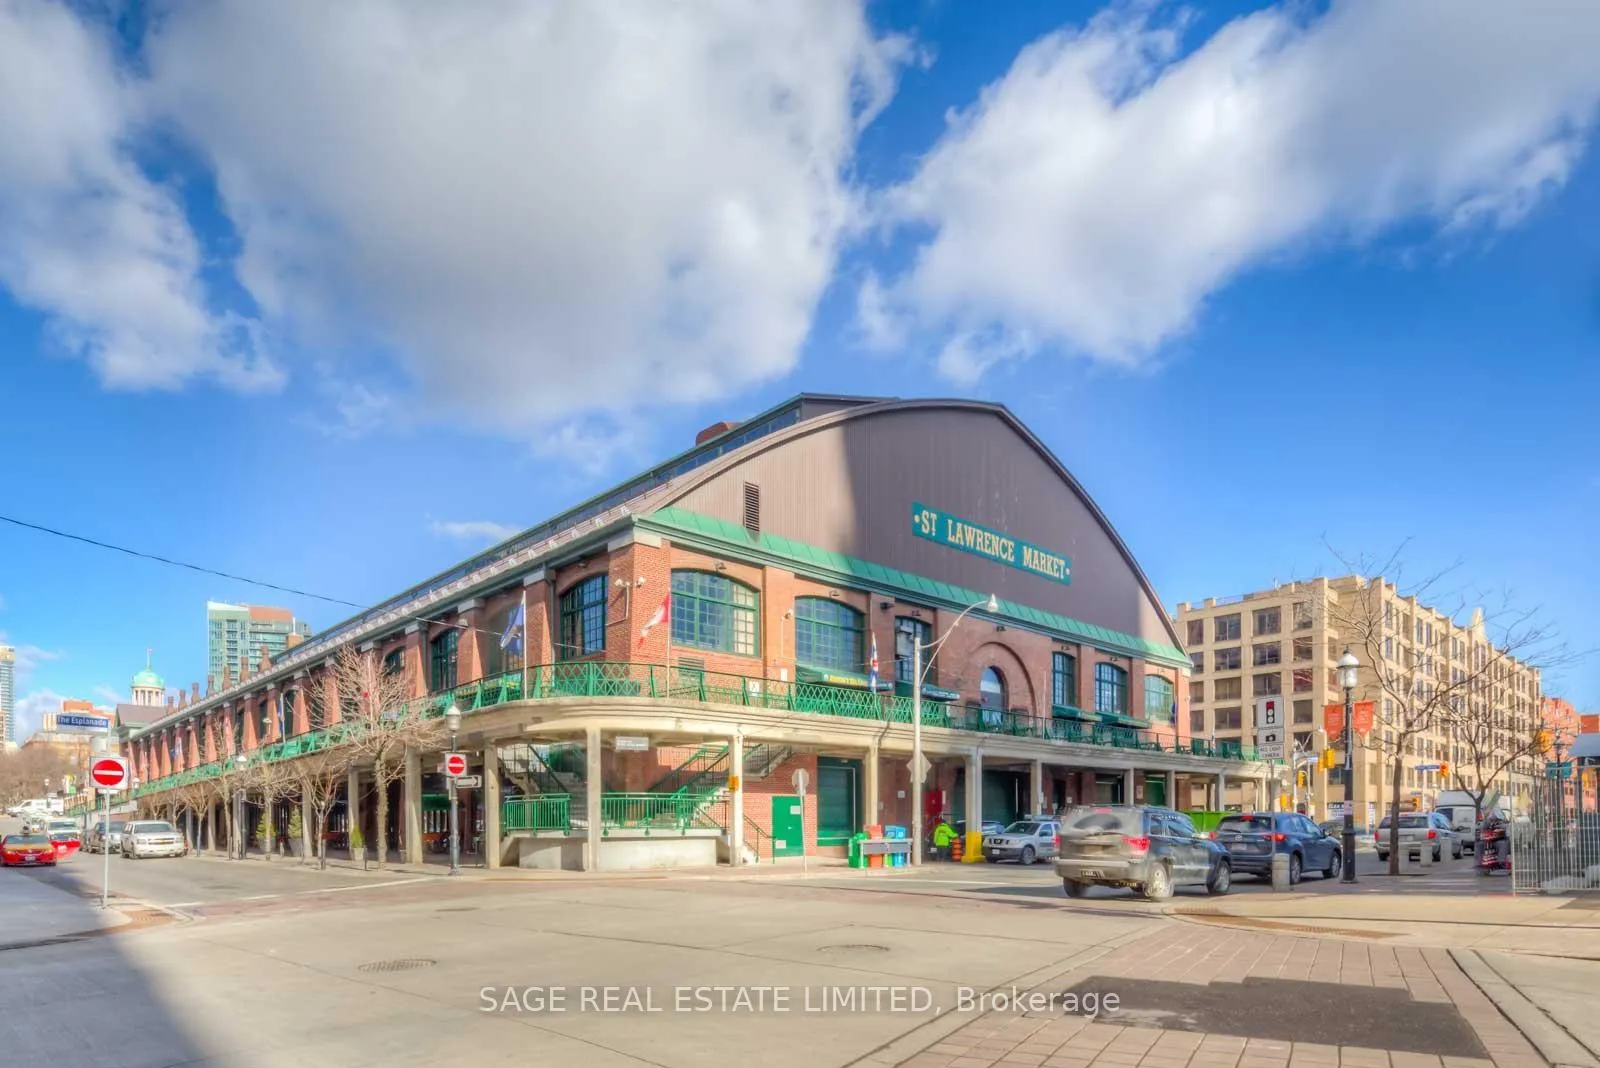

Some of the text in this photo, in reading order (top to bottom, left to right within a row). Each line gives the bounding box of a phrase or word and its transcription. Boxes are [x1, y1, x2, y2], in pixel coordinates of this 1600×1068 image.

[921, 510, 1065, 579] ST LAWRENCE MARKET
[71, 716, 107, 726] Esplanade
